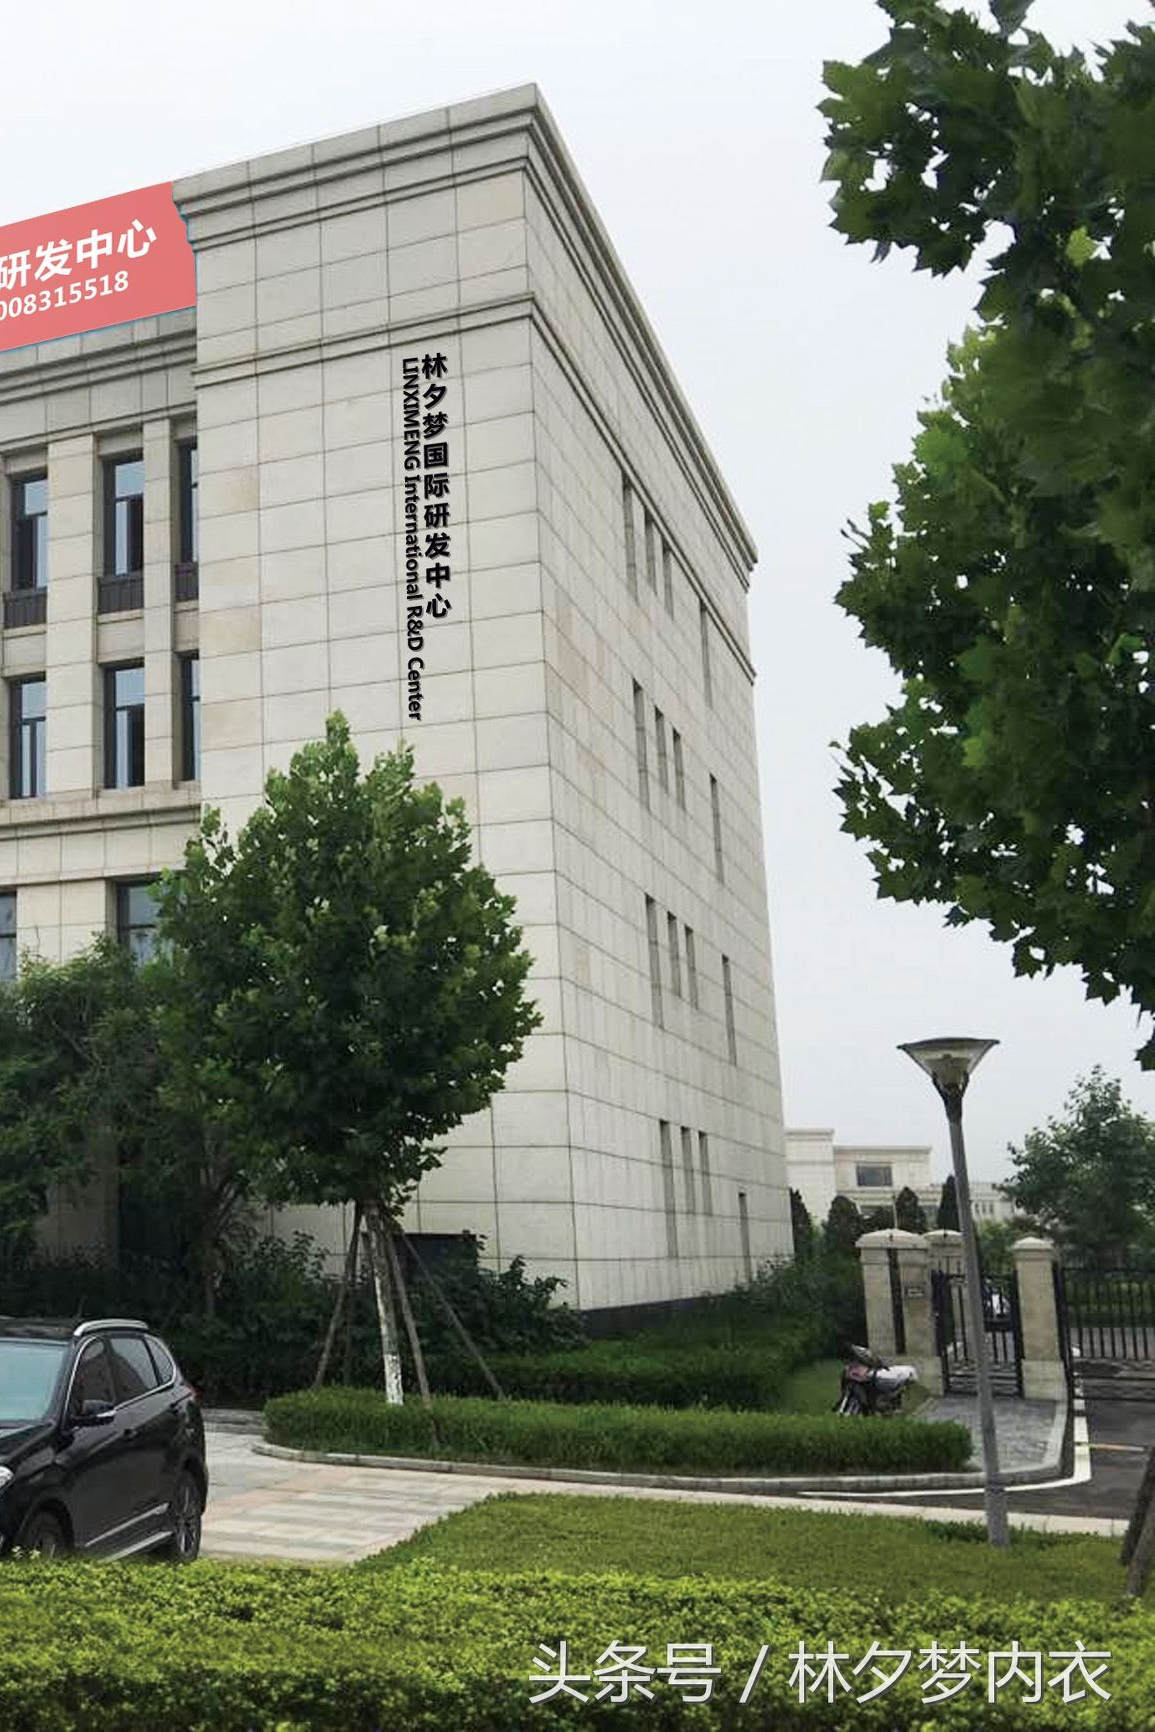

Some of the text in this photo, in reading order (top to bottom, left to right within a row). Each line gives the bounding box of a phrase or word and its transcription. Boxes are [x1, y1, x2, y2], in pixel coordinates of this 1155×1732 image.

[402, 357, 425, 721] LINXIMENG International R&D Center
[421, 352, 451, 619] 林夕梦国际研发中心
